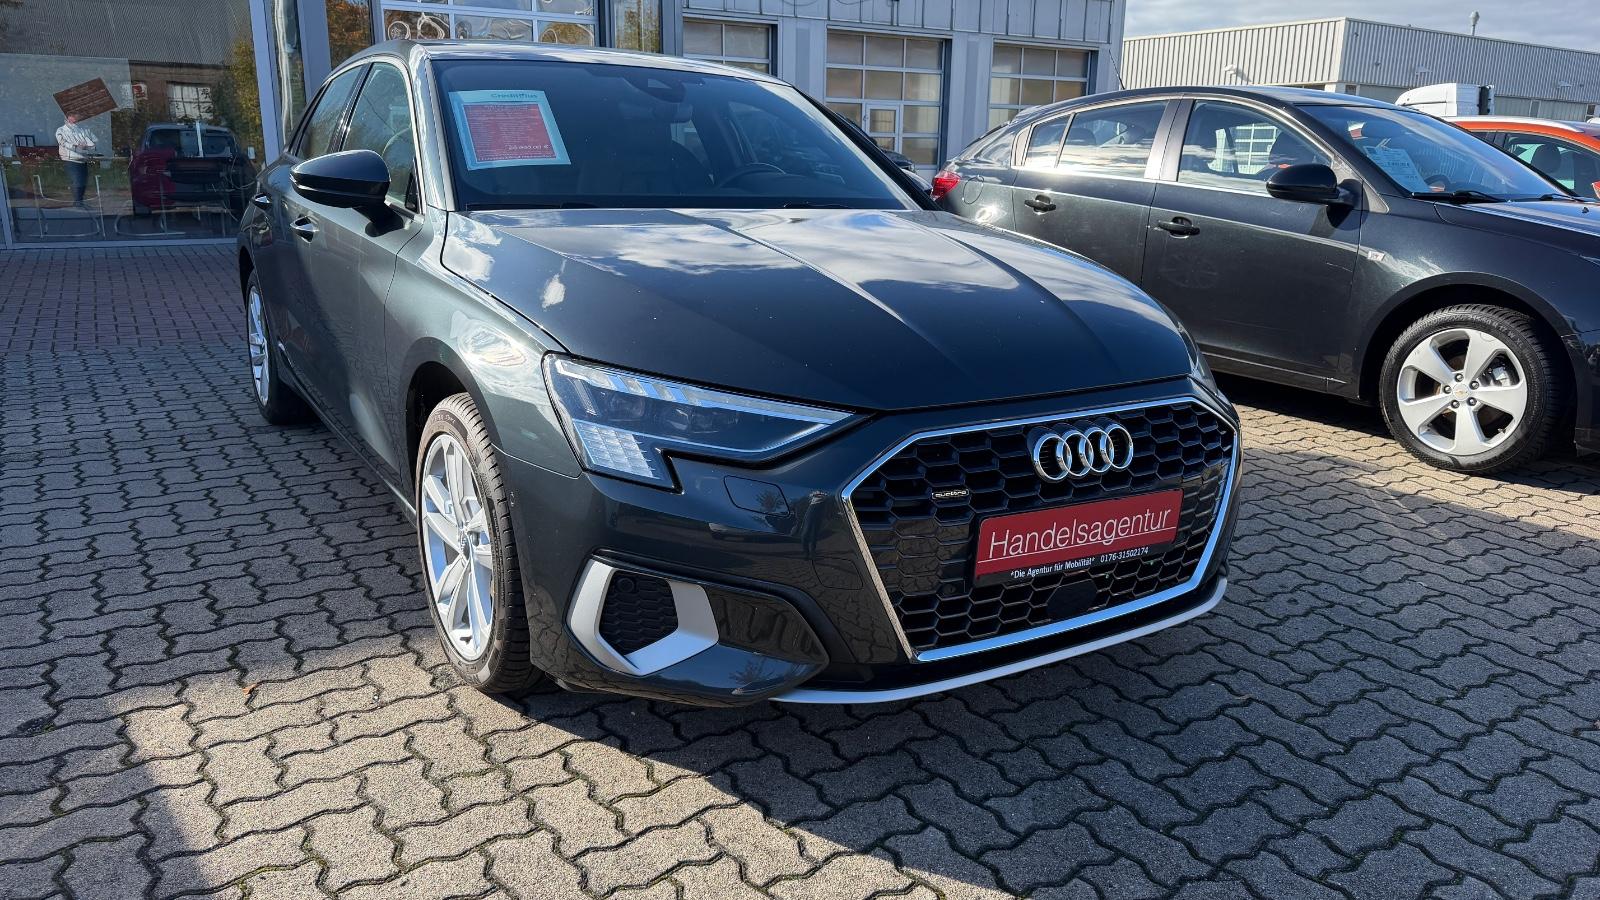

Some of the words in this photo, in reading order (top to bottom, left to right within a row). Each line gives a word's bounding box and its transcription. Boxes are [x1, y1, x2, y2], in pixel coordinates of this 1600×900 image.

[988, 508, 1171, 559] Handelsagentur
[1027, 563, 1053, 577] Agentur
[1054, 561, 1064, 572] für
[1100, 546, 1149, 563] 0176-31502174
